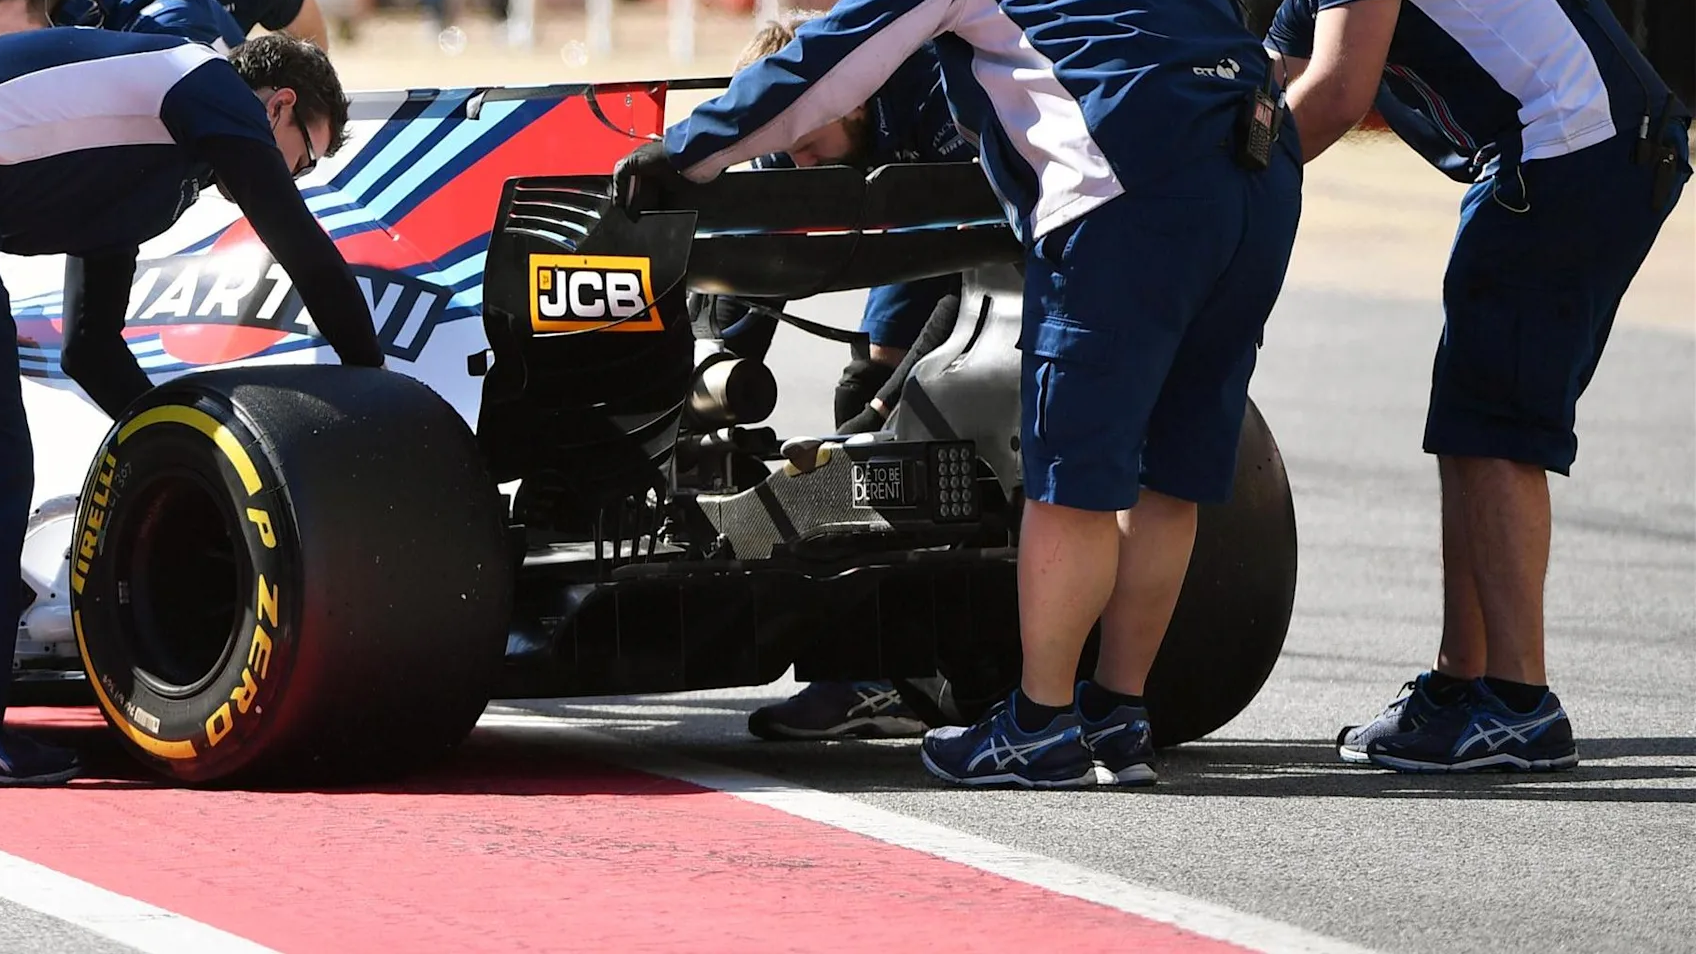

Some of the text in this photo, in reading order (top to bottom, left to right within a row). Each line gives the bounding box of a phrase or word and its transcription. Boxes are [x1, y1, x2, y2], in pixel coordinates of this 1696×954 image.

[538, 268, 646, 318] JCB
[71, 446, 117, 596] PIRELLI
[873, 468, 887, 483] TO
[888, 467, 901, 482] BE
[205, 507, 279, 747] P ZERO
